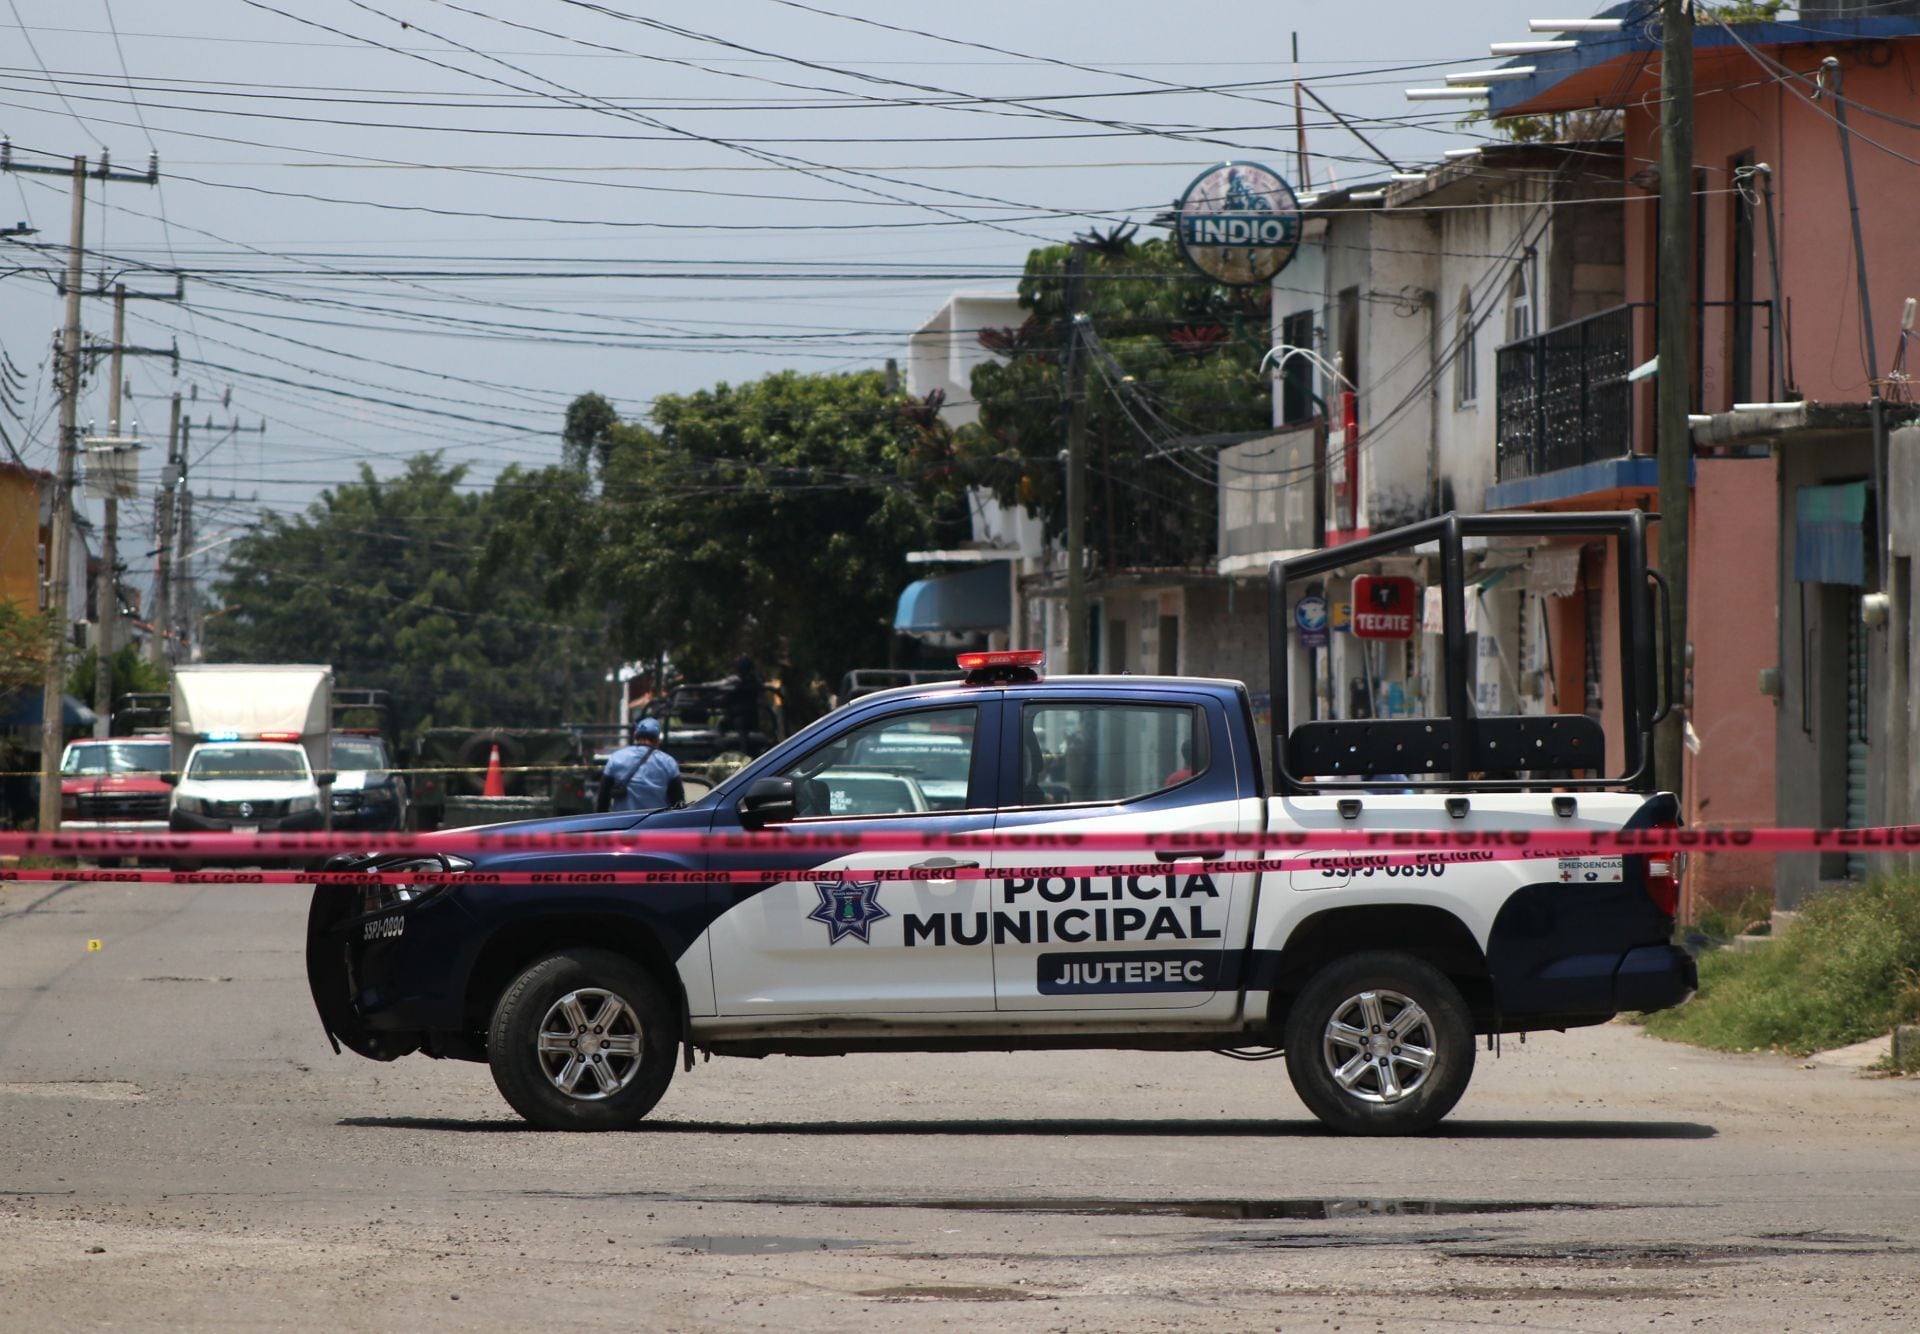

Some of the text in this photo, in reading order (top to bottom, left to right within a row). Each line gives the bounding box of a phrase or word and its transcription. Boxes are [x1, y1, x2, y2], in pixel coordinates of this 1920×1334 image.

[1195, 219, 1284, 243] INDIO
[1357, 613, 1411, 630] TECATE
[1558, 861, 1623, 869] EMERGENCIAS
[1003, 874, 1220, 903] POLICIA
[363, 915, 405, 940] SSPJ-0890
[903, 905, 1221, 947] MUNICIPAL
[1055, 960, 1204, 984] JIUTEPEC
